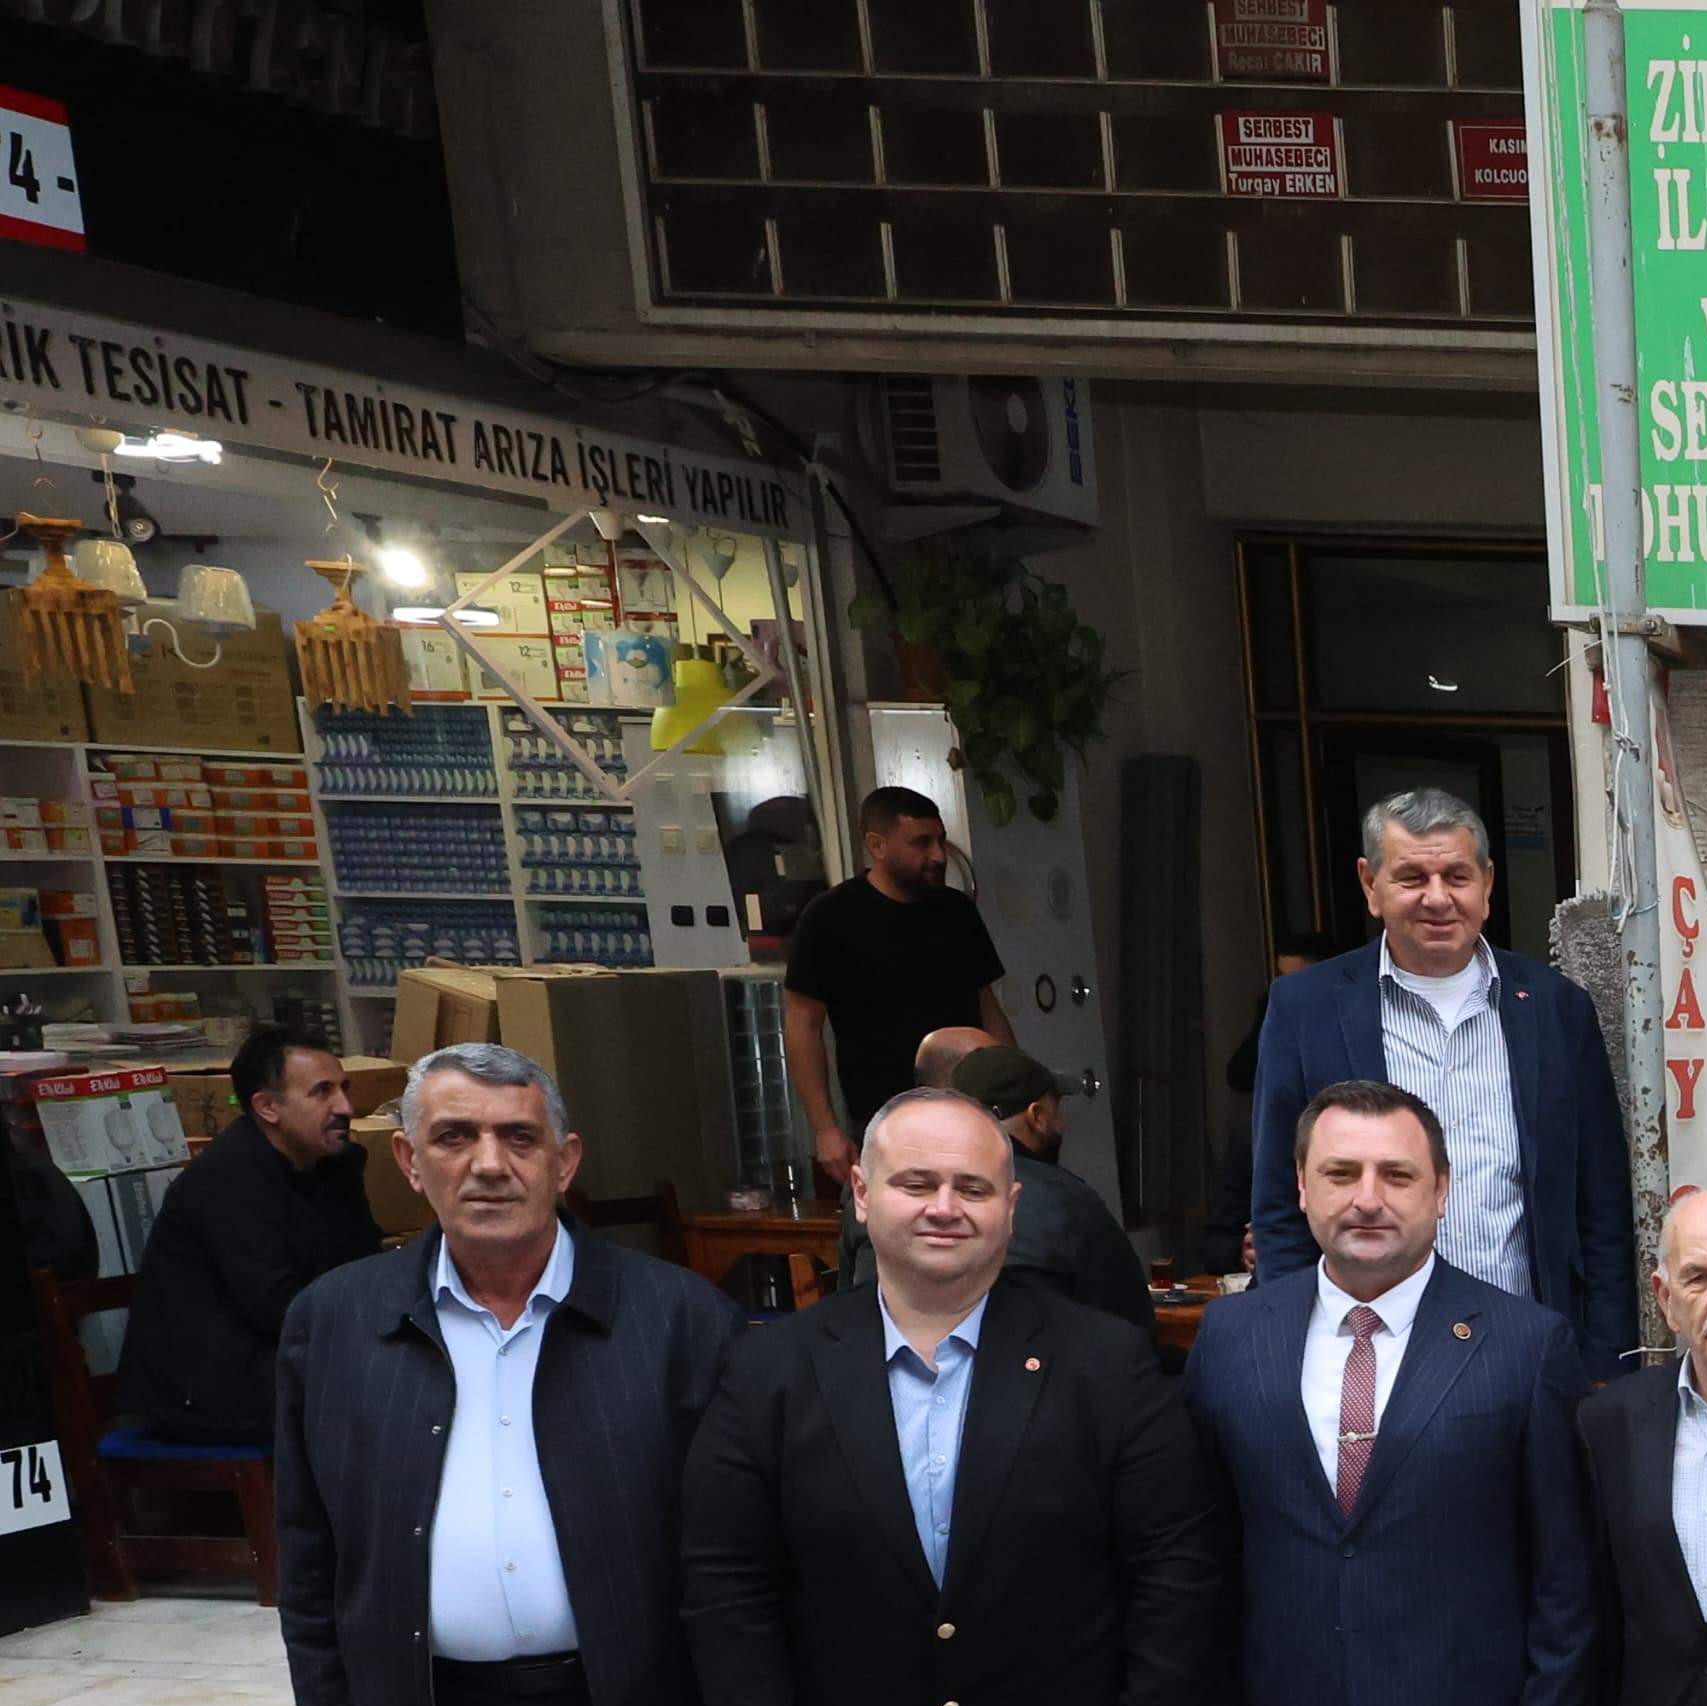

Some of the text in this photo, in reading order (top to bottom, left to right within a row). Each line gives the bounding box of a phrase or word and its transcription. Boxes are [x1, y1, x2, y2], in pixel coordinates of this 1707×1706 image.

[1243, 118, 1312, 138] SERBEST
[1228, 174, 1335, 196] Turgay ERKEN
[69, 335, 249, 425] TESİSAT
[295, 382, 457, 465] TAMİRAT
[473, 420, 571, 488] ARIZA
[575, 428, 675, 507] İŞLERİ
[681, 463, 790, 530] YAPILIR
[1664, 875, 1706, 1120] ÇAY
[0, 1444, 52, 1510] 74
